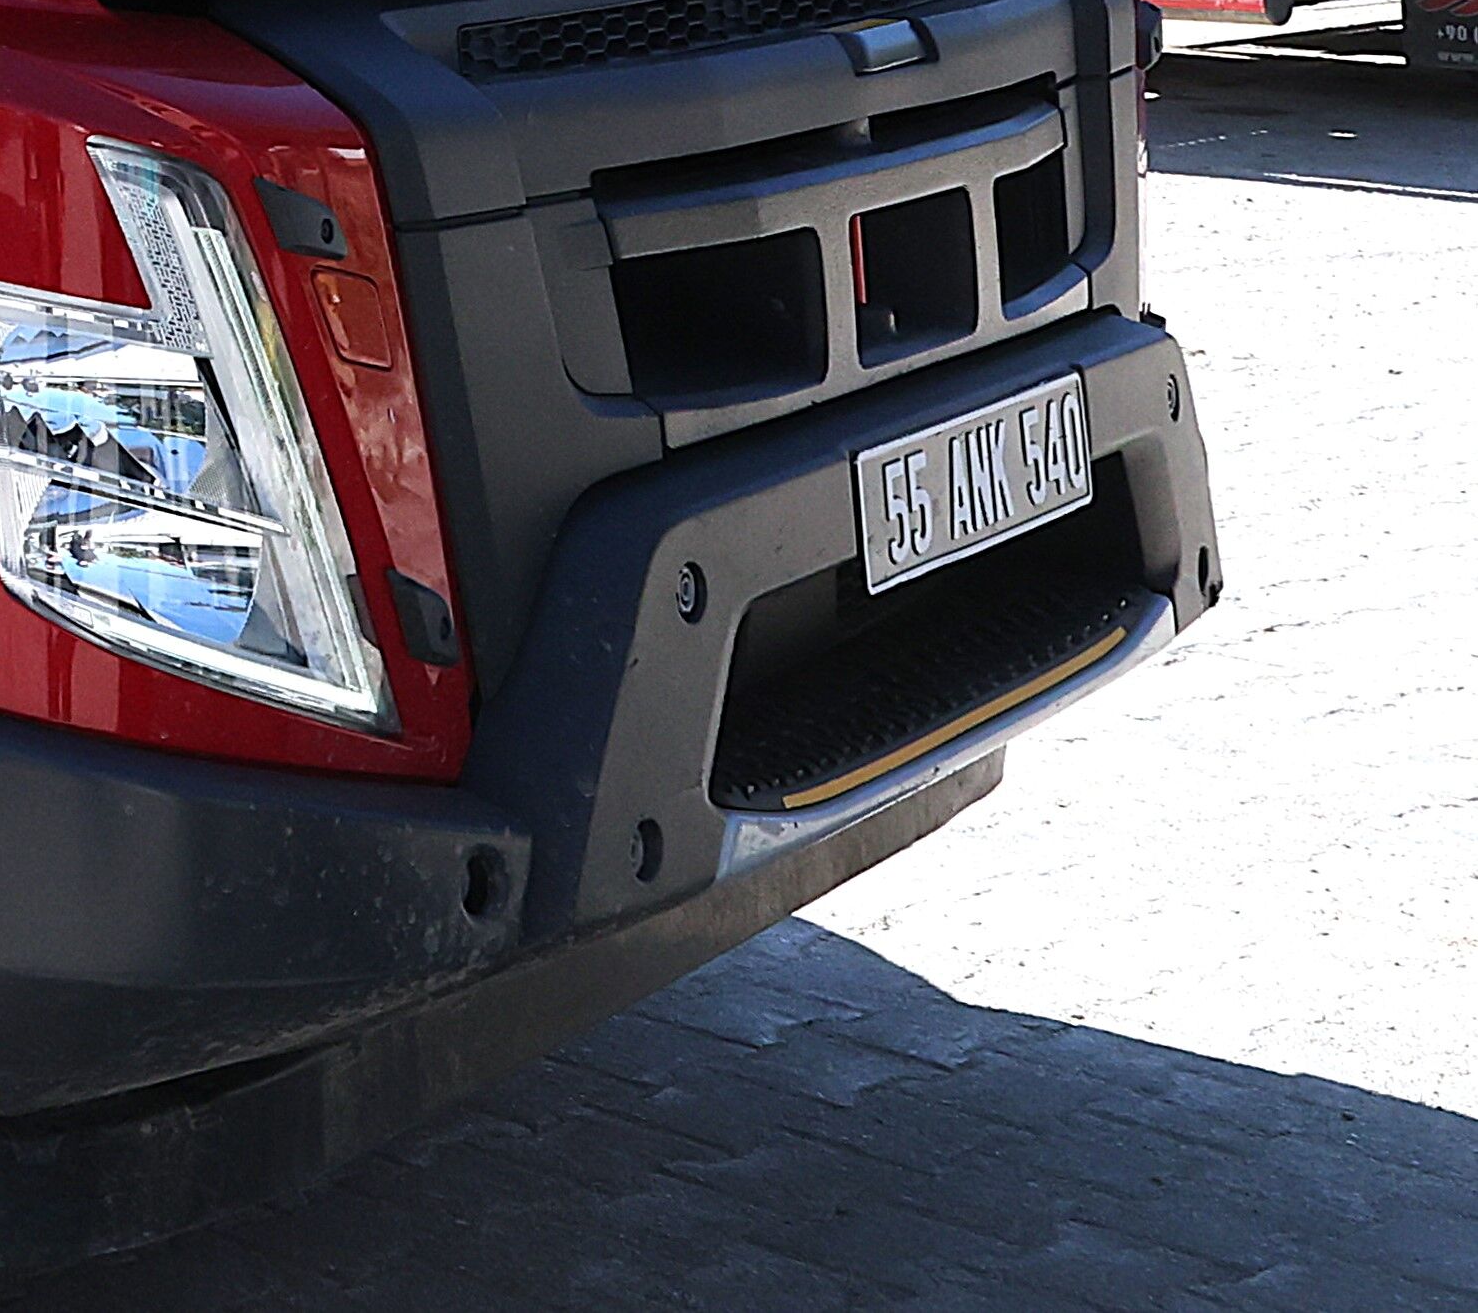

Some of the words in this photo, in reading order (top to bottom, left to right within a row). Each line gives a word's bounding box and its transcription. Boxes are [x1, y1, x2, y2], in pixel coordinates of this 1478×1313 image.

[882, 449, 934, 565] 55
[948, 419, 1015, 541] ANK
[1019, 392, 1086, 506] 540
